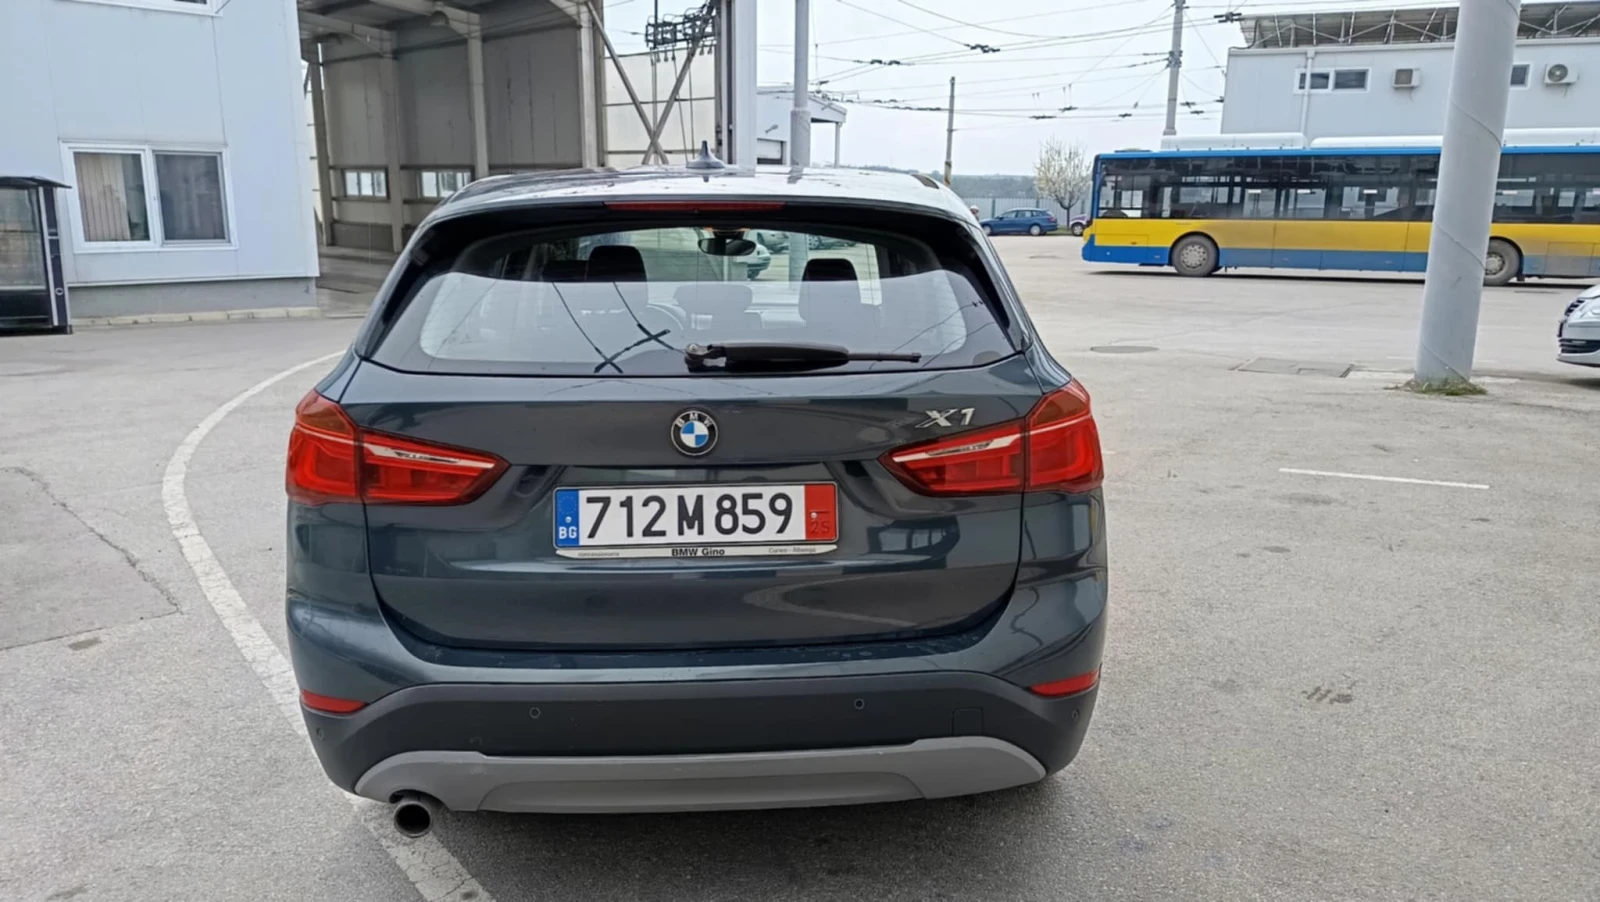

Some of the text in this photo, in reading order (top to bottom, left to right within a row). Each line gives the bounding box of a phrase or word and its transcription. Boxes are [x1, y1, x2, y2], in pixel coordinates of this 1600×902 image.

[675, 411, 714, 428] BMW
[914, 407, 975, 428] X1
[559, 526, 577, 539] BG
[671, 548, 725, 557] BMW Gino
